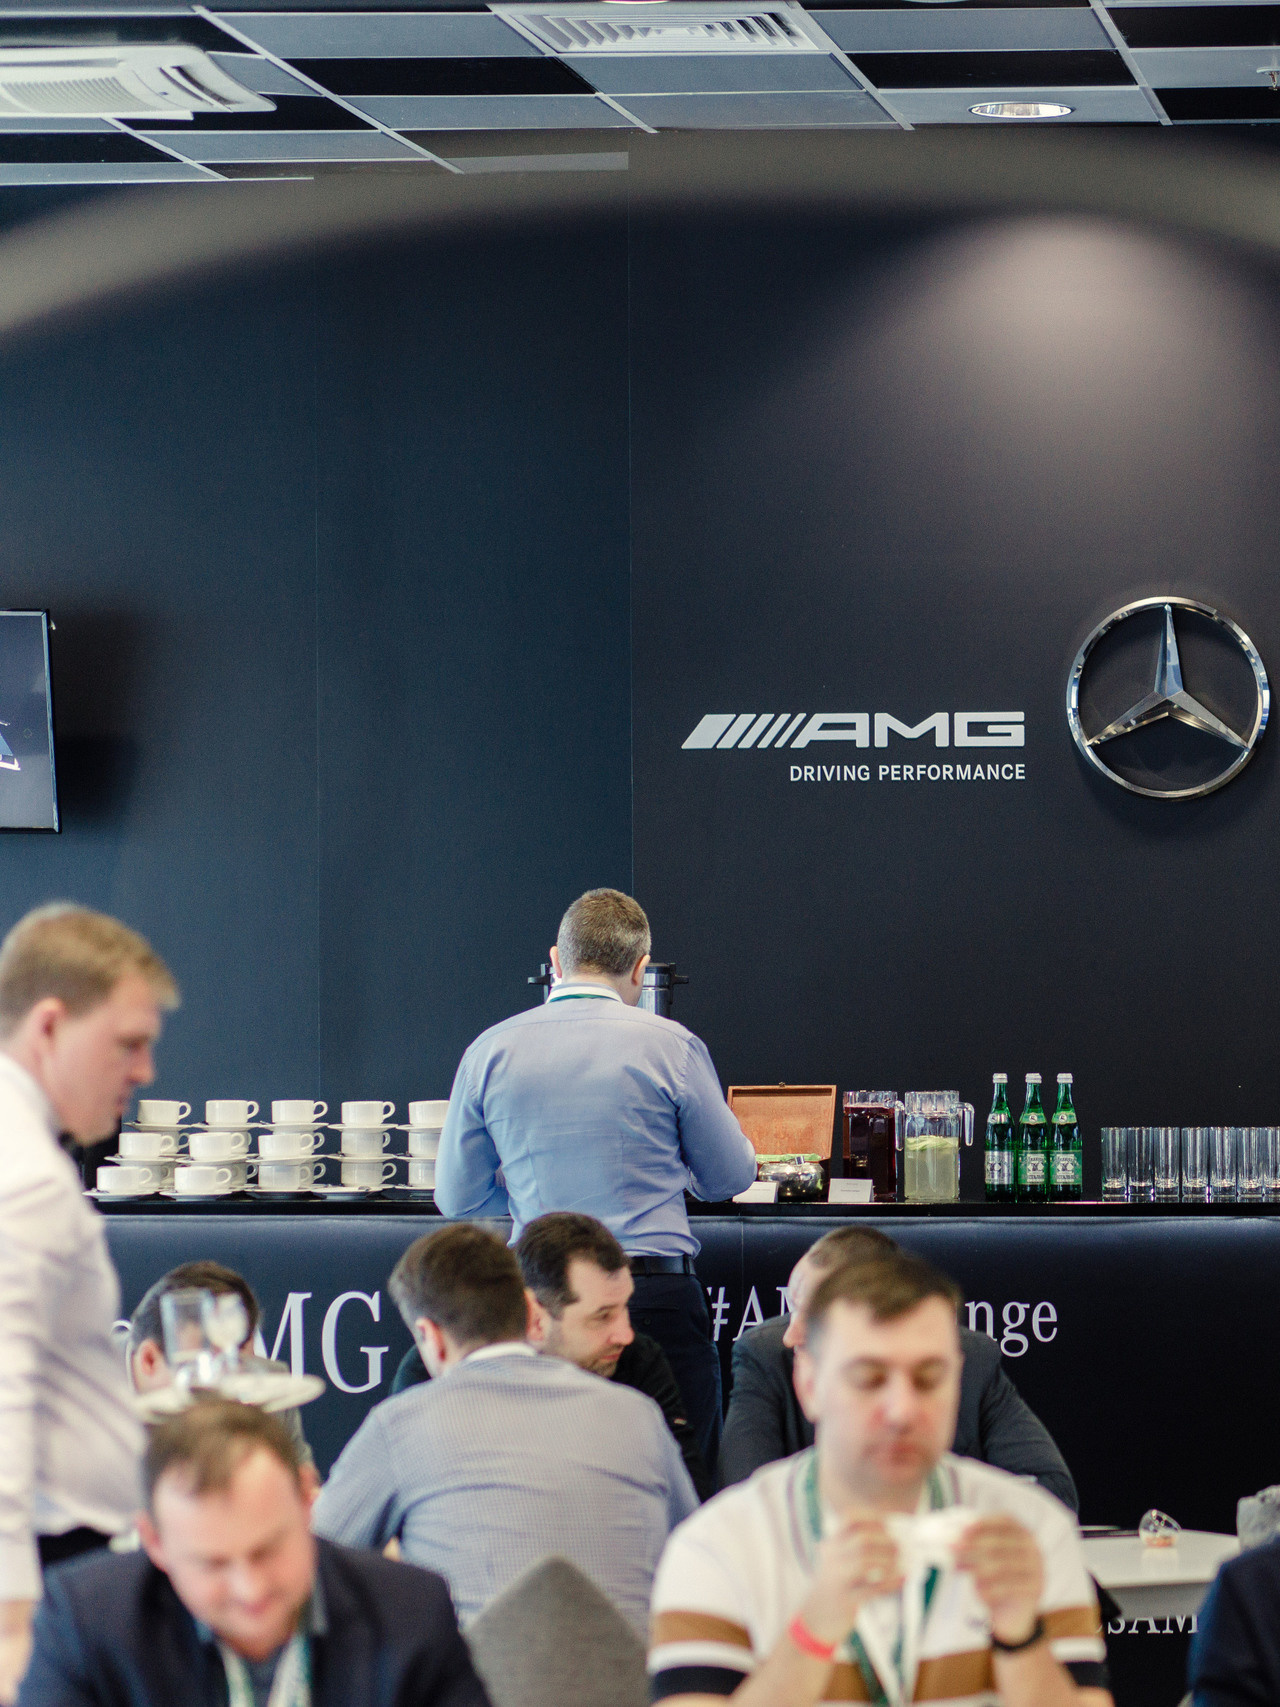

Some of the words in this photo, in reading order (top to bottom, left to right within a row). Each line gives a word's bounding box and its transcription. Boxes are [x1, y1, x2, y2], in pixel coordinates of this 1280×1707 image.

[790, 711, 1025, 748] AMG
[790, 765, 870, 782] DRIVING
[878, 764, 1026, 781] PERFORMANCE
